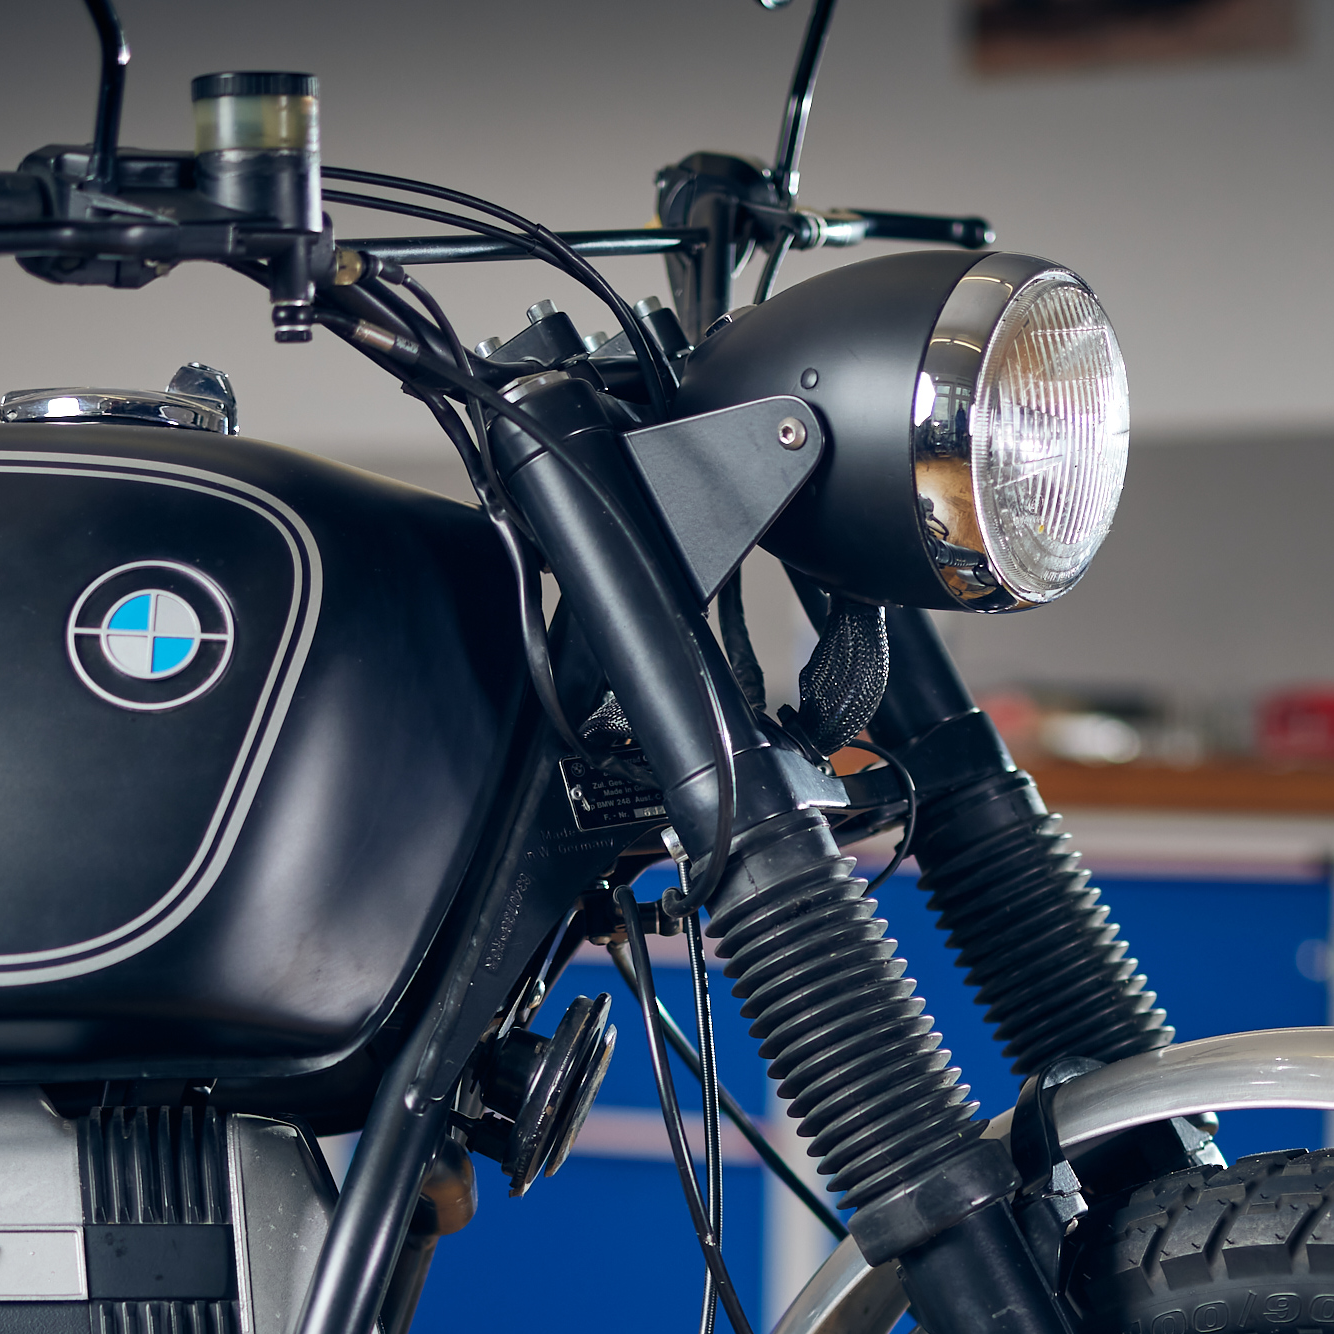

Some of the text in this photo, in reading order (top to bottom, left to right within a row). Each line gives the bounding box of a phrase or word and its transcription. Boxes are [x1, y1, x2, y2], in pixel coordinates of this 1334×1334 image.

[603, 787, 623, 796] Made
[596, 800, 615, 809] BMW
[617, 797, 631, 806] 248
[540, 828, 576, 841] Made
